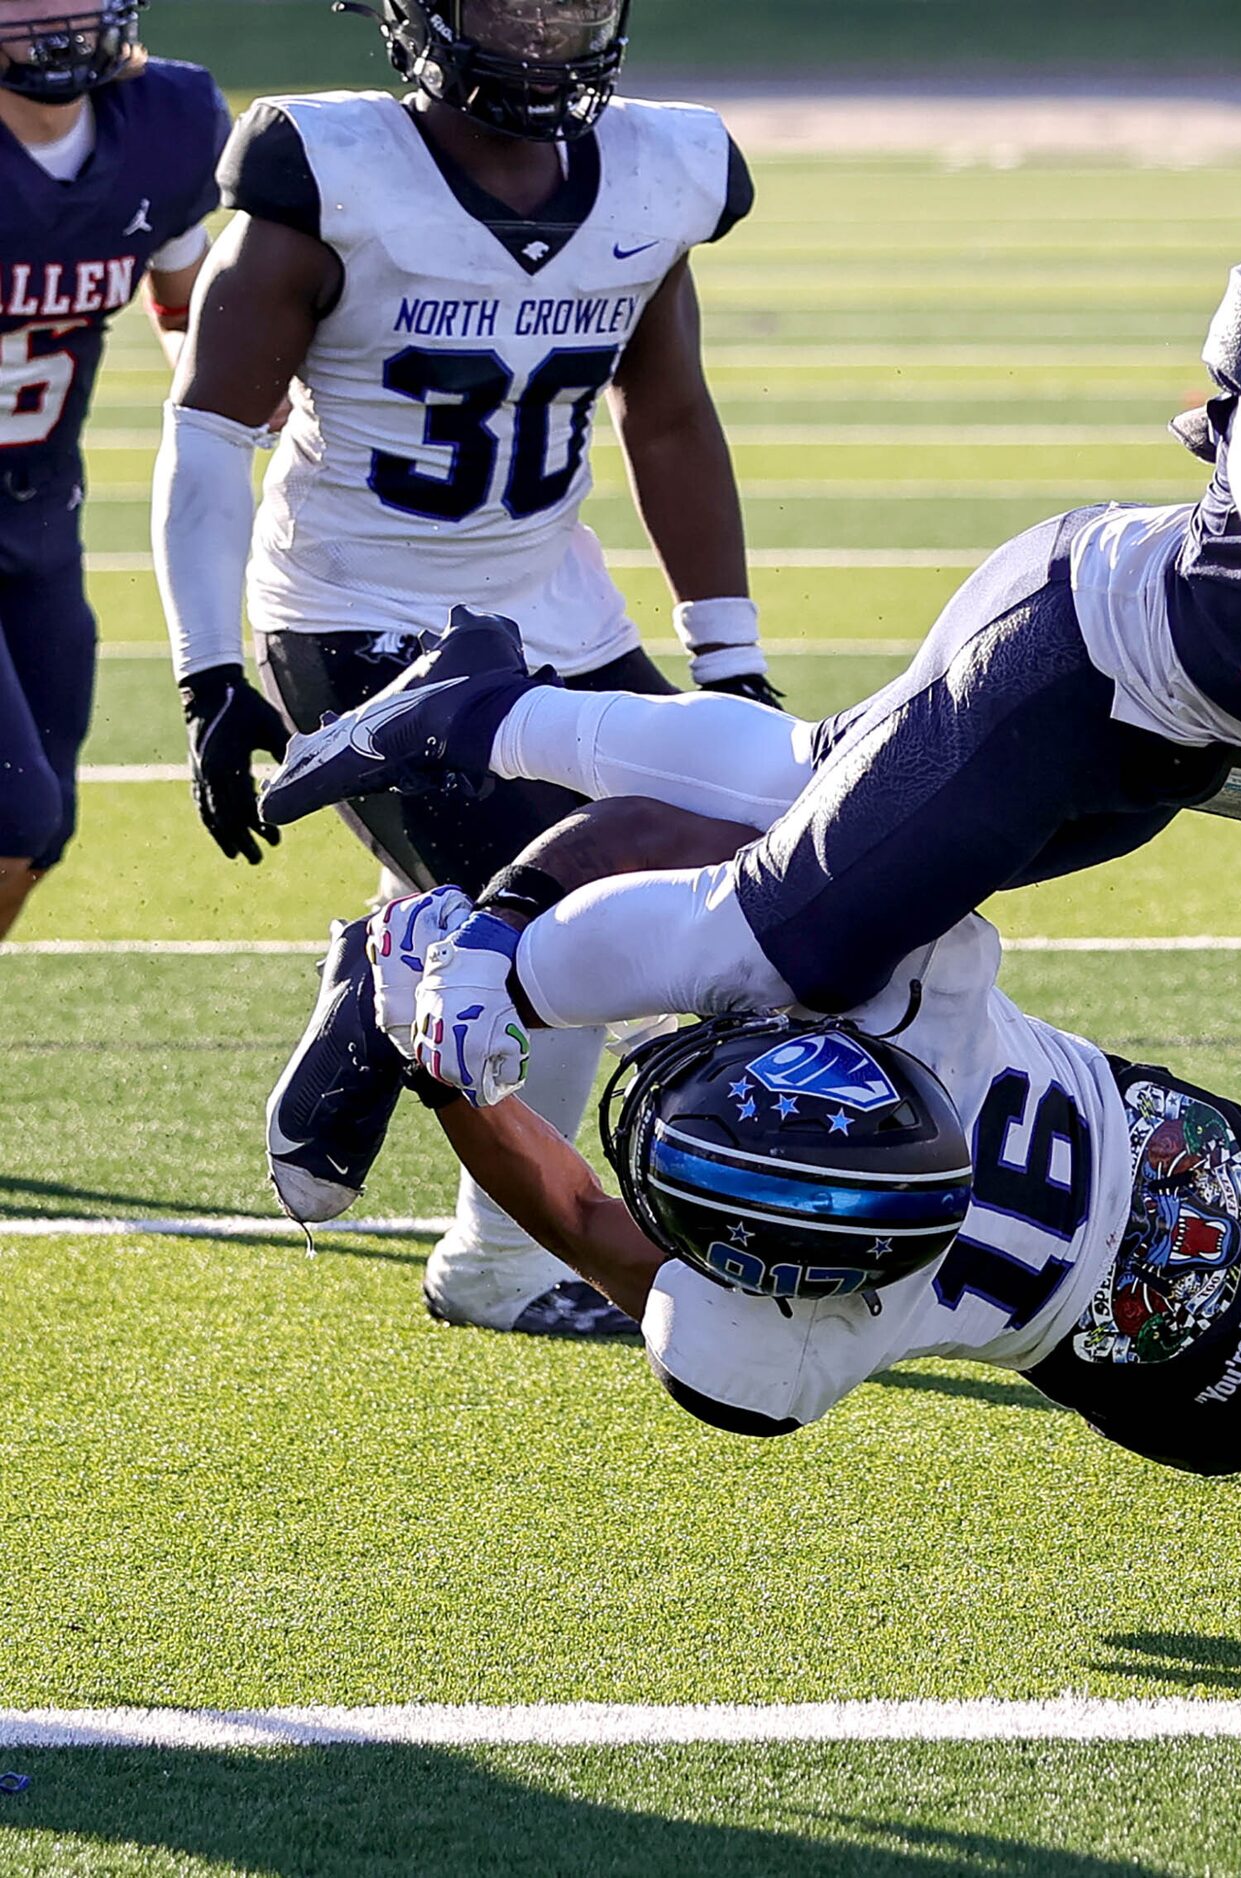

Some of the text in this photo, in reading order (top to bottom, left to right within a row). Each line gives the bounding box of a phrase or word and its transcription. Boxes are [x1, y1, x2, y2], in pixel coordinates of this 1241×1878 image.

[0, 255, 136, 316] LLEN
[394, 296, 640, 337] NORTH CROWLEY
[366, 344, 619, 523] 30
[931, 1066, 1094, 1332] 16
[1197, 1275, 1222, 1298] TOO
